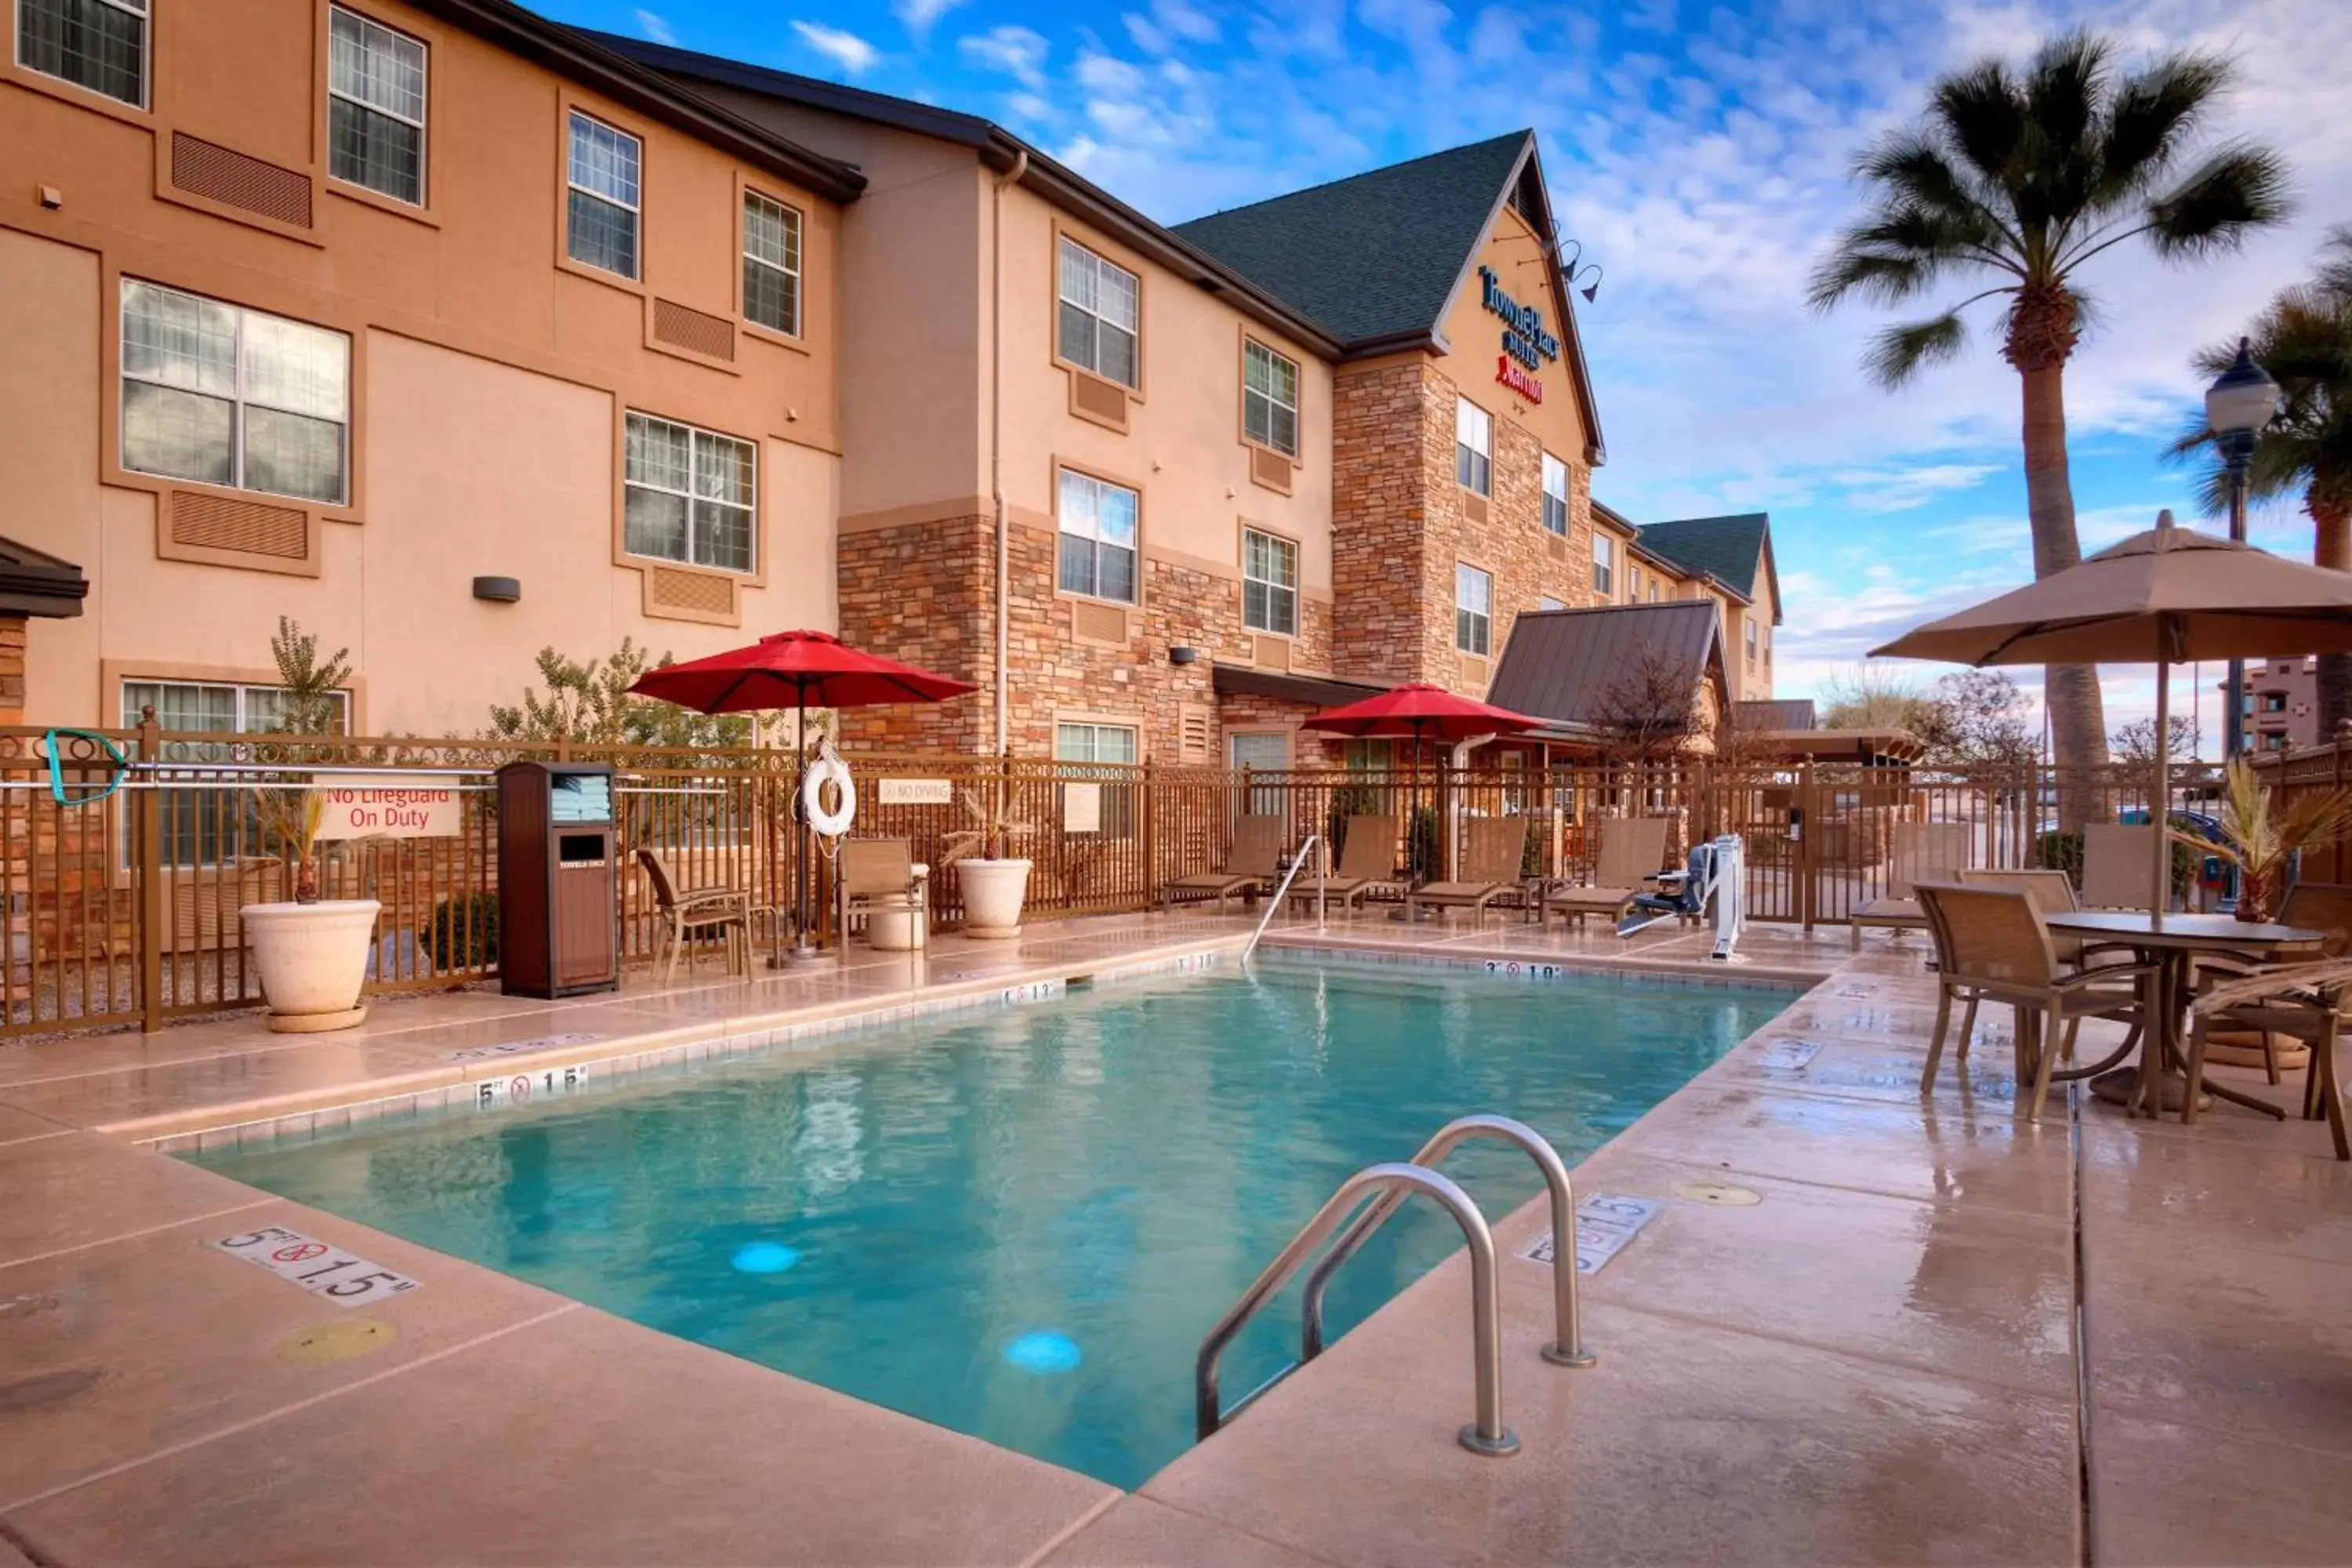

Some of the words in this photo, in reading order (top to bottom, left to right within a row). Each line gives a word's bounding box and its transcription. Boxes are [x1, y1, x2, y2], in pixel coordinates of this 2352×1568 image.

[328, 789, 354, 804] No
[898, 785, 912, 799] NO
[915, 784, 948, 799] DIVING
[350, 808, 377, 827] On
[386, 808, 429, 829] Duty
